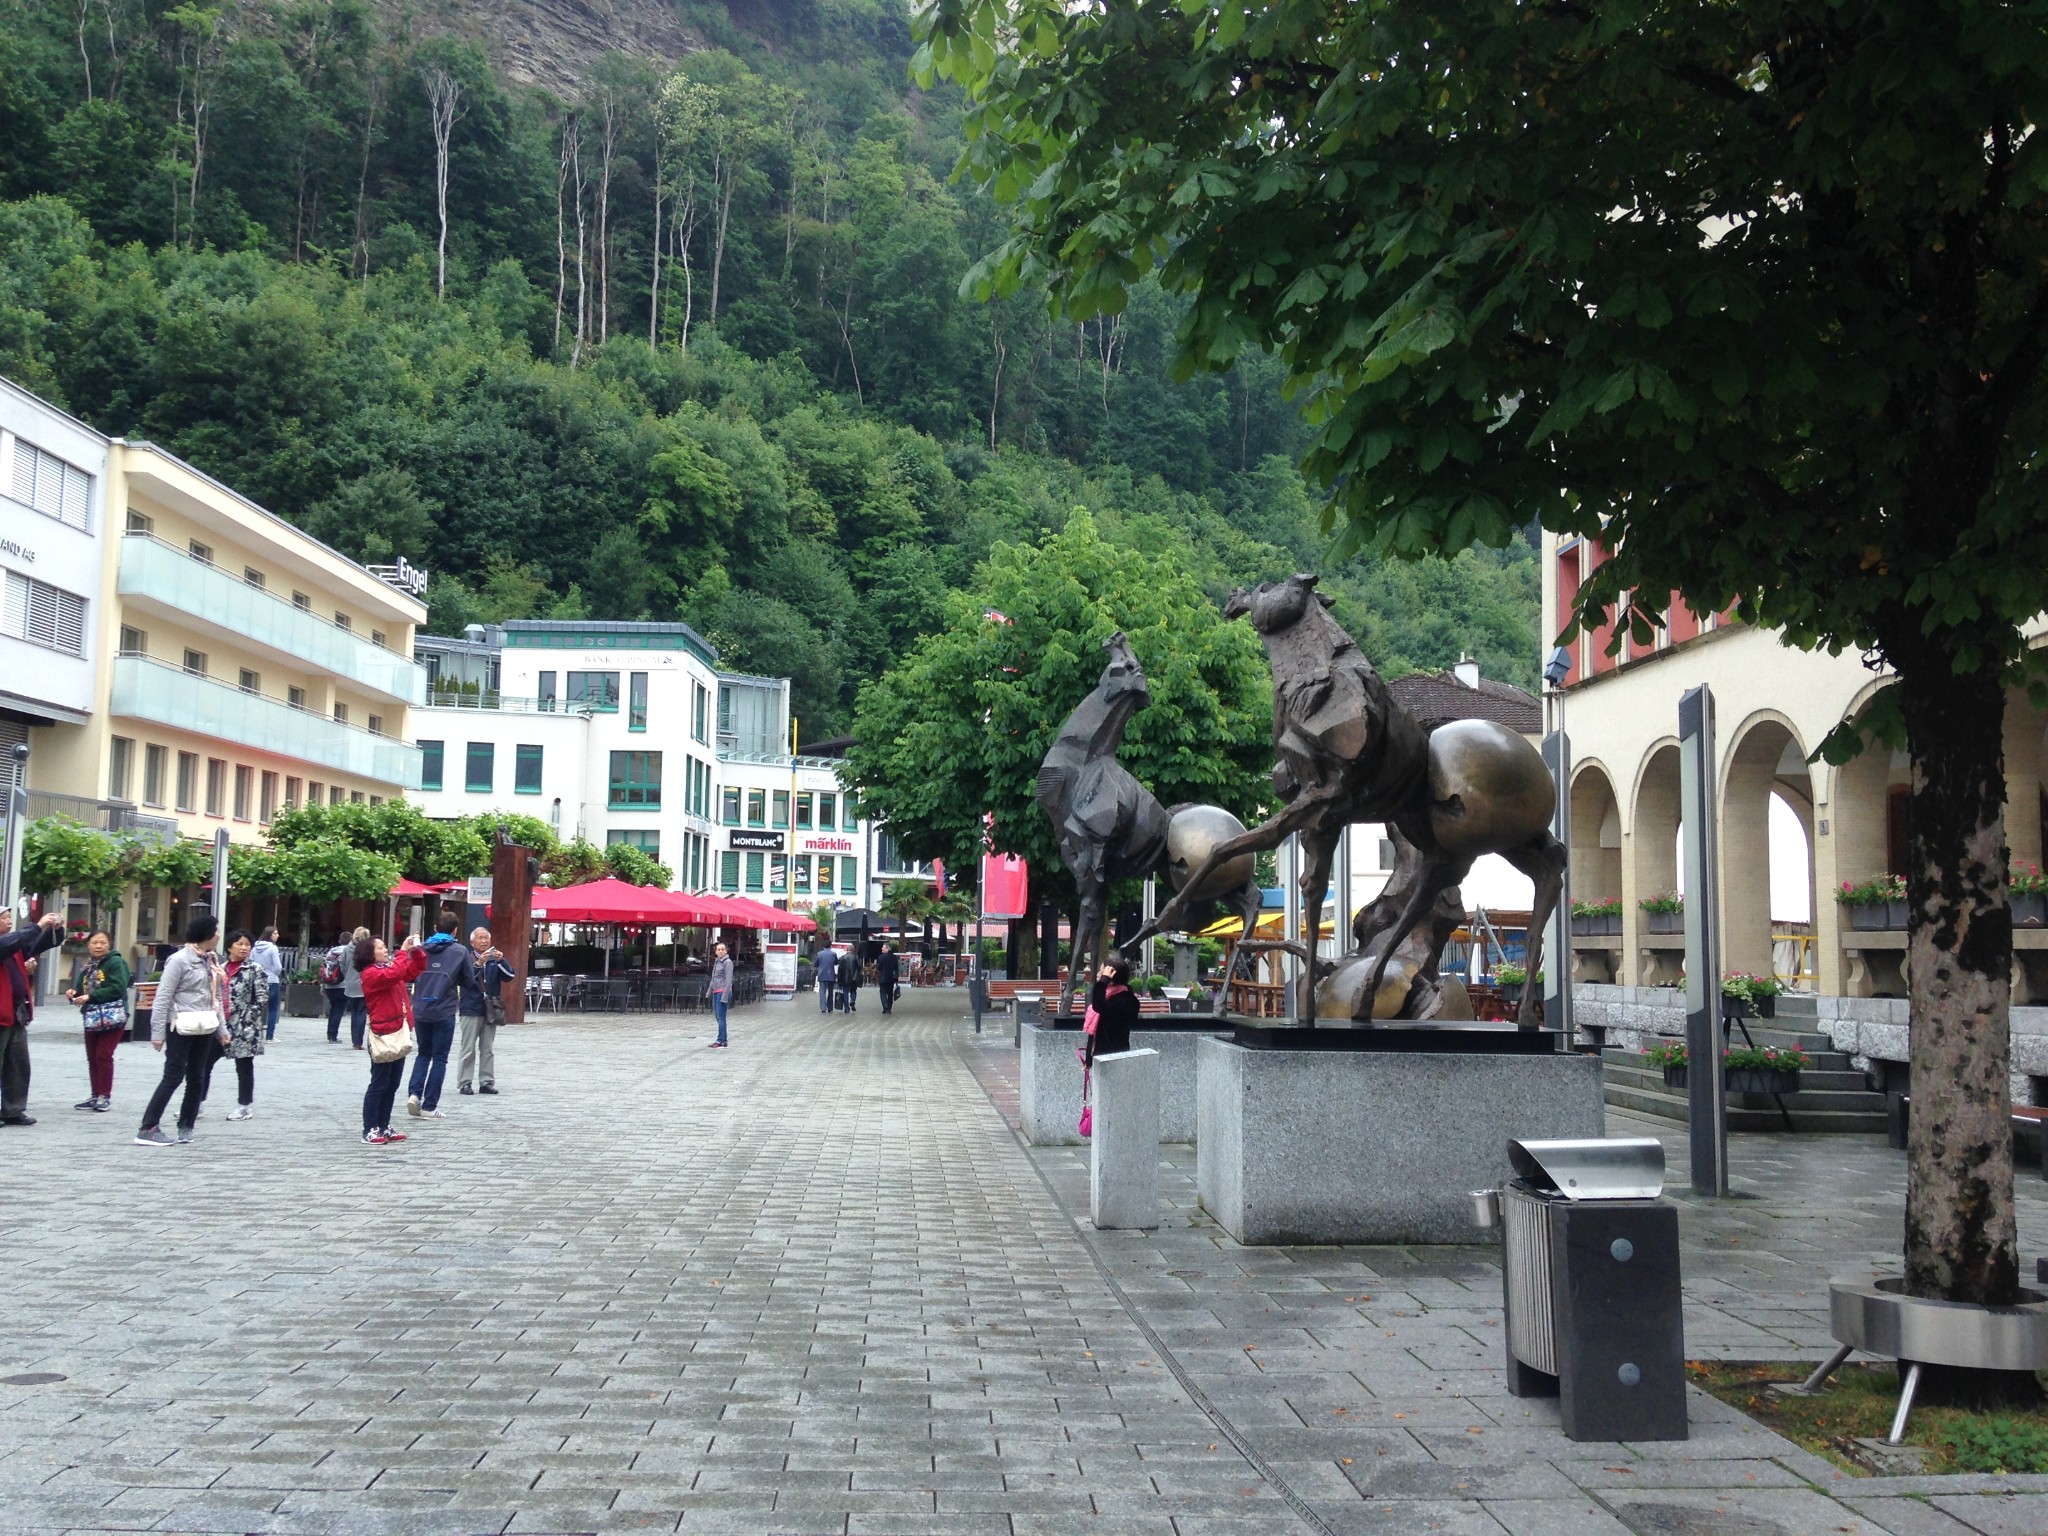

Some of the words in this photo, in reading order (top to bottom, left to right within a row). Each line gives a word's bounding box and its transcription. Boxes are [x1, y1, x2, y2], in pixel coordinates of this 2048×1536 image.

[397, 555, 428, 595] Engel
[584, 656, 611, 664] BANK
[732, 837, 777, 847] MONTBLANC
[805, 837, 852, 851] märklin
[472, 889, 491, 897] Engel
